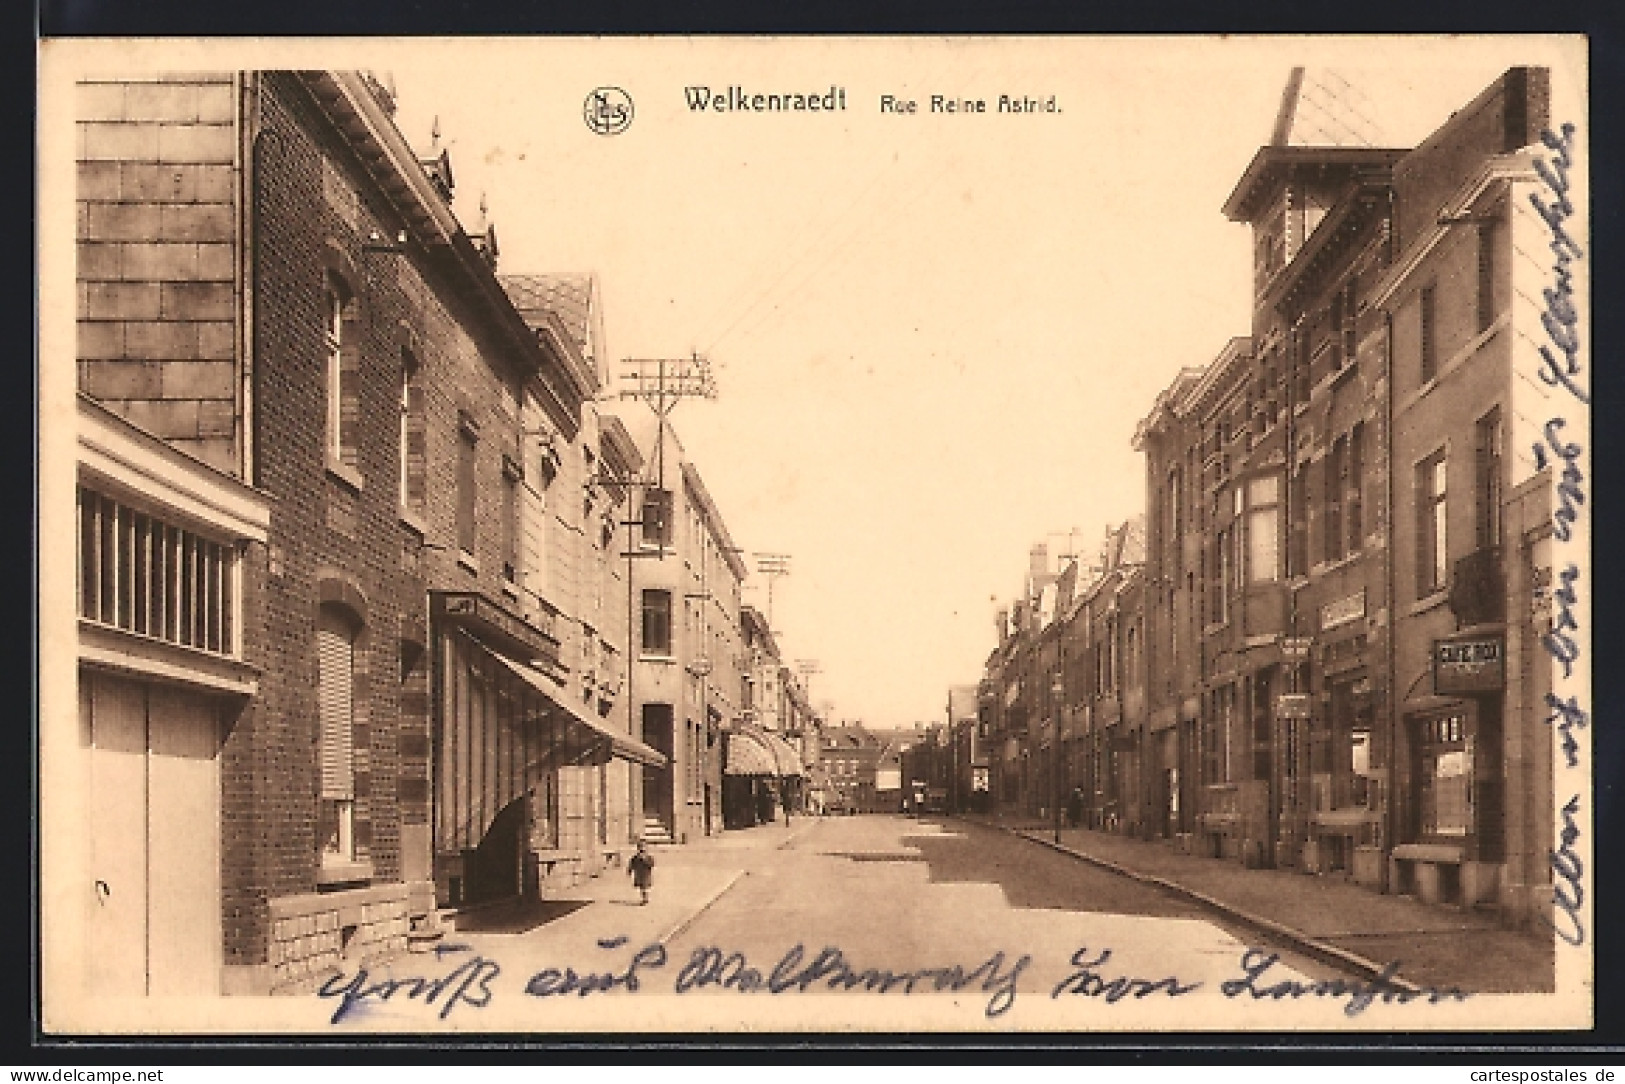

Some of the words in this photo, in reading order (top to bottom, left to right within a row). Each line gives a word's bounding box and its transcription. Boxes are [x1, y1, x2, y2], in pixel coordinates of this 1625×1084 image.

[683, 86, 848, 113] Welkenraedt
[881, 94, 919, 114] Rue
[930, 94, 986, 114] Reine
[997, 94, 1064, 114] Astrid.
